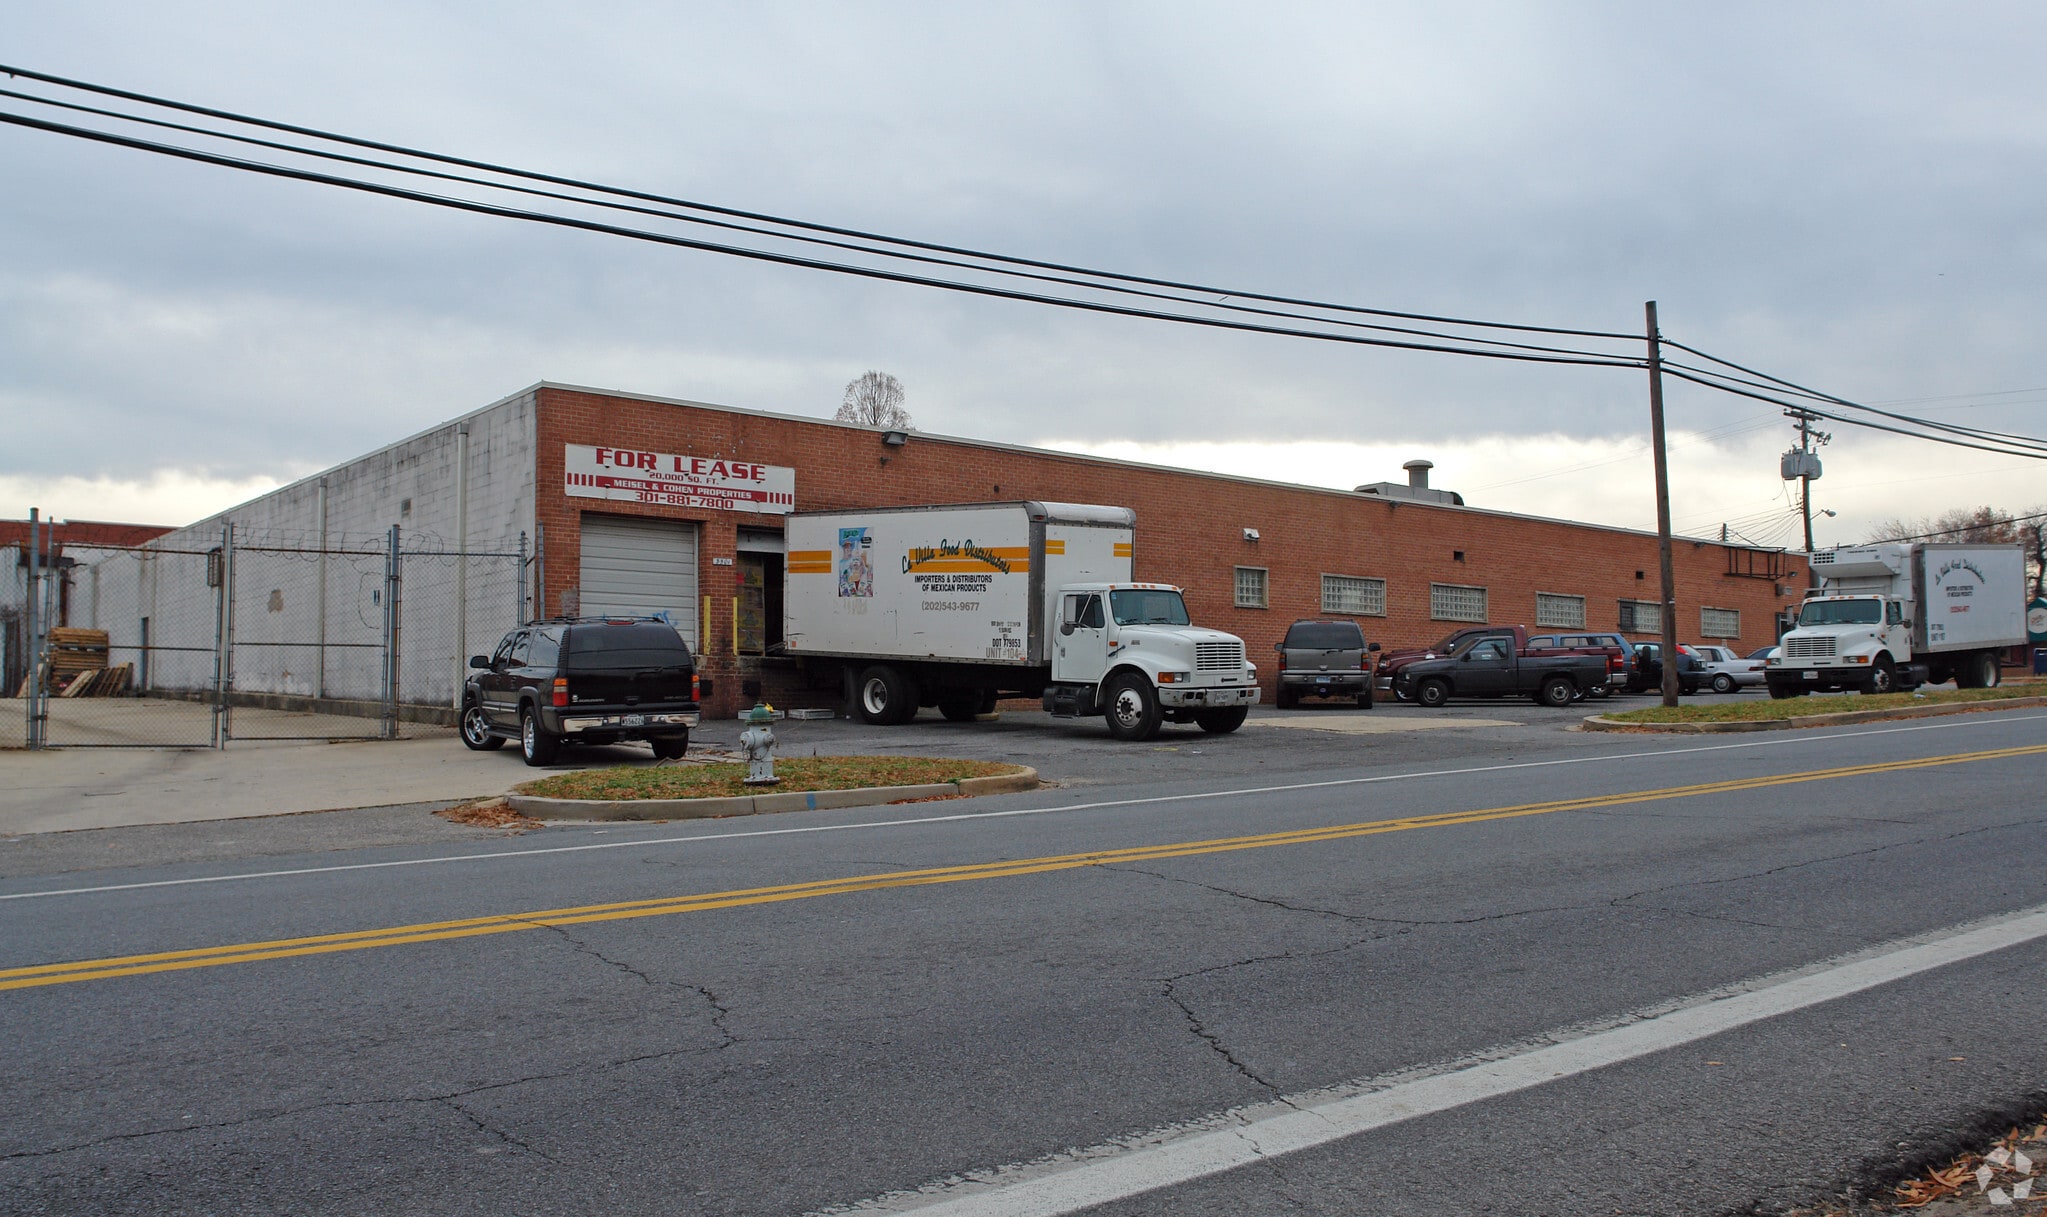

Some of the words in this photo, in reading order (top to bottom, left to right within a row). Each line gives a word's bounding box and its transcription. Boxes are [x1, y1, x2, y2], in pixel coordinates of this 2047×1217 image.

[596, 448, 657, 470] FOR
[674, 456, 766, 482] LEASE
[649, 471, 684, 482] 20,000
[706, 477, 719, 486] FT.
[613, 479, 650, 490] MEISEL
[651, 482, 660, 491] &
[663, 484, 694, 494] COHEN
[697, 487, 752, 500] PROPERTIES
[635, 491, 734, 510] 301-881-7800
[939, 538, 960, 557] Food
[964, 539, 1011, 575] Distributors
[914, 575, 946, 583] IMPORTERS
[947, 575, 951, 583] &
[952, 575, 993, 583] DISTRIBUTORS
[922, 584, 930, 592] OF
[930, 584, 956, 592] MEXICAN
[956, 584, 987, 592] PRODUCTS
[921, 600, 980, 611] (202)543-9677
[992, 638, 1002, 648] DOT
[985, 647, 1001, 659] UNIT
